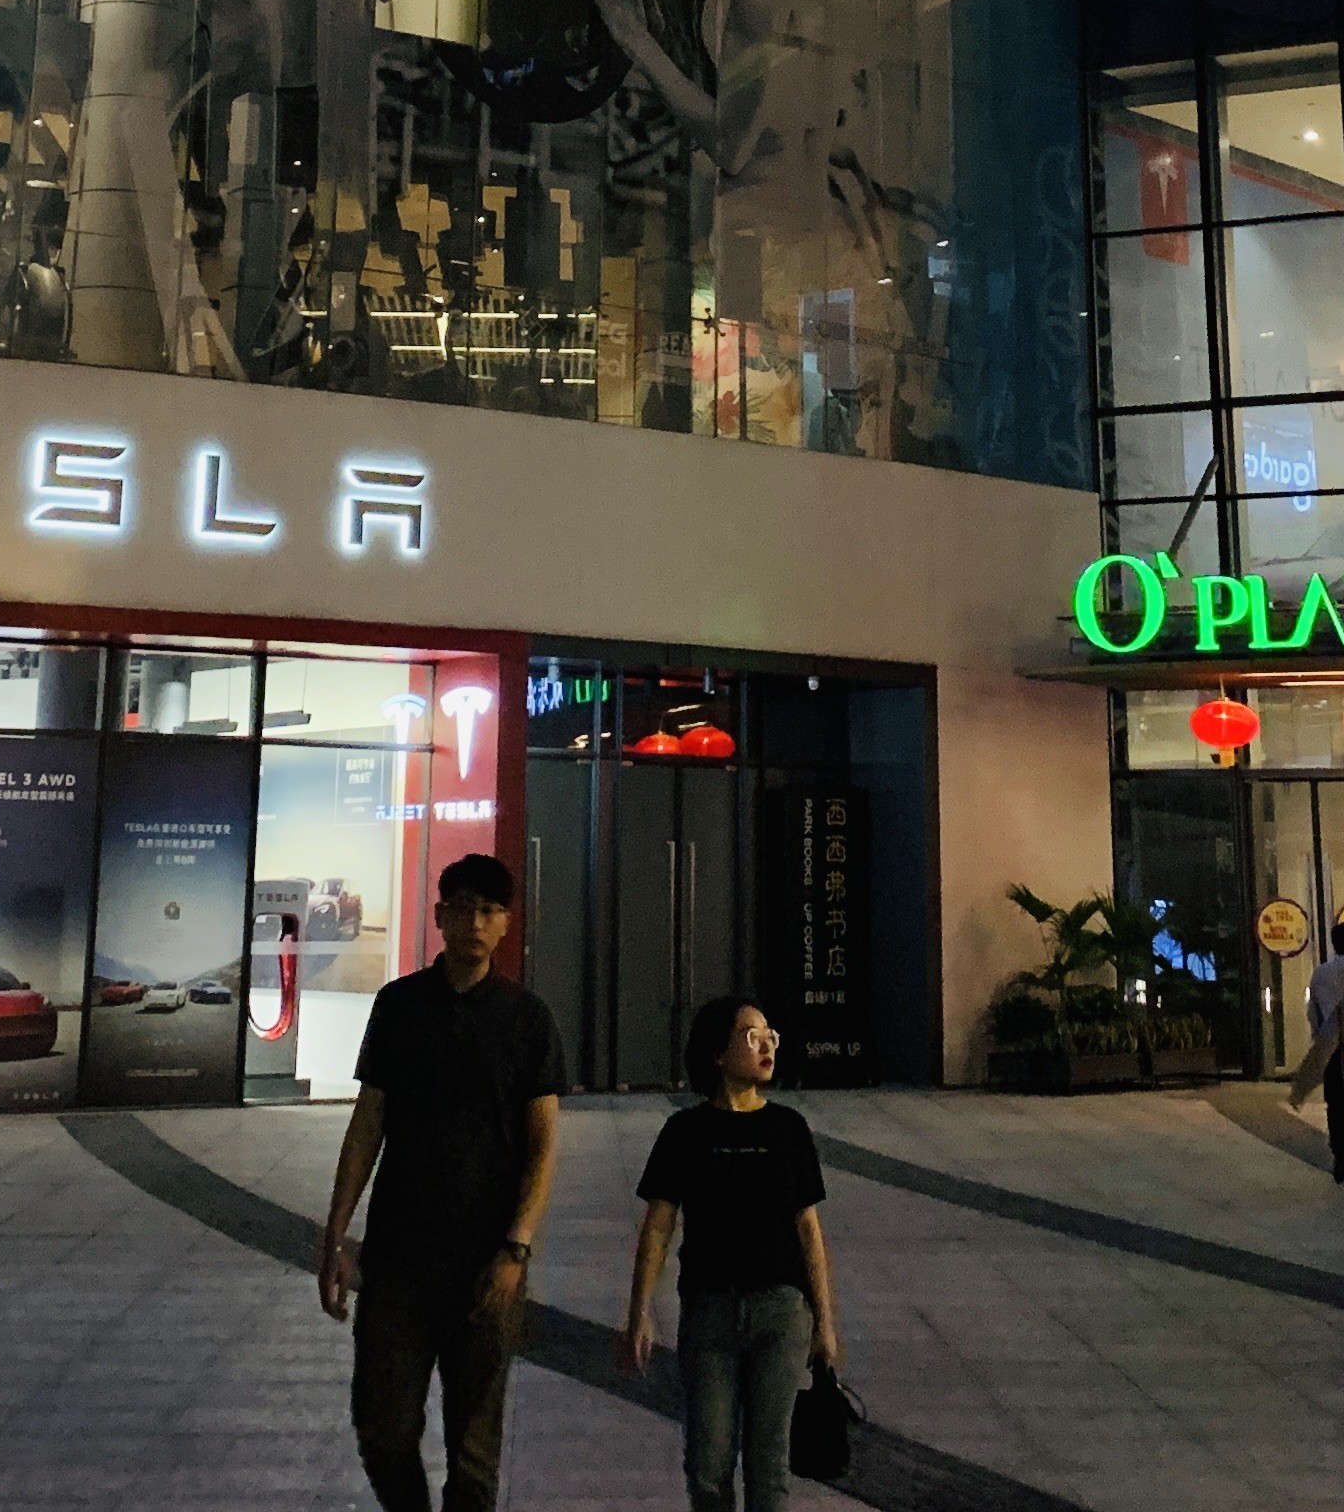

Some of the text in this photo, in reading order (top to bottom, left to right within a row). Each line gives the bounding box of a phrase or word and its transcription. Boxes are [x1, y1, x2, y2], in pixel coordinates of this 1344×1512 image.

[23, 773, 32, 786] 3
[38, 773, 76, 787] AWD
[433, 800, 493, 820] TESLA
[804, 798, 813, 834] PARK
[257, 892, 299, 903] TESLA
[825, 798, 847, 977] 西西弗书店
[804, 925, 813, 980] COFFEE
